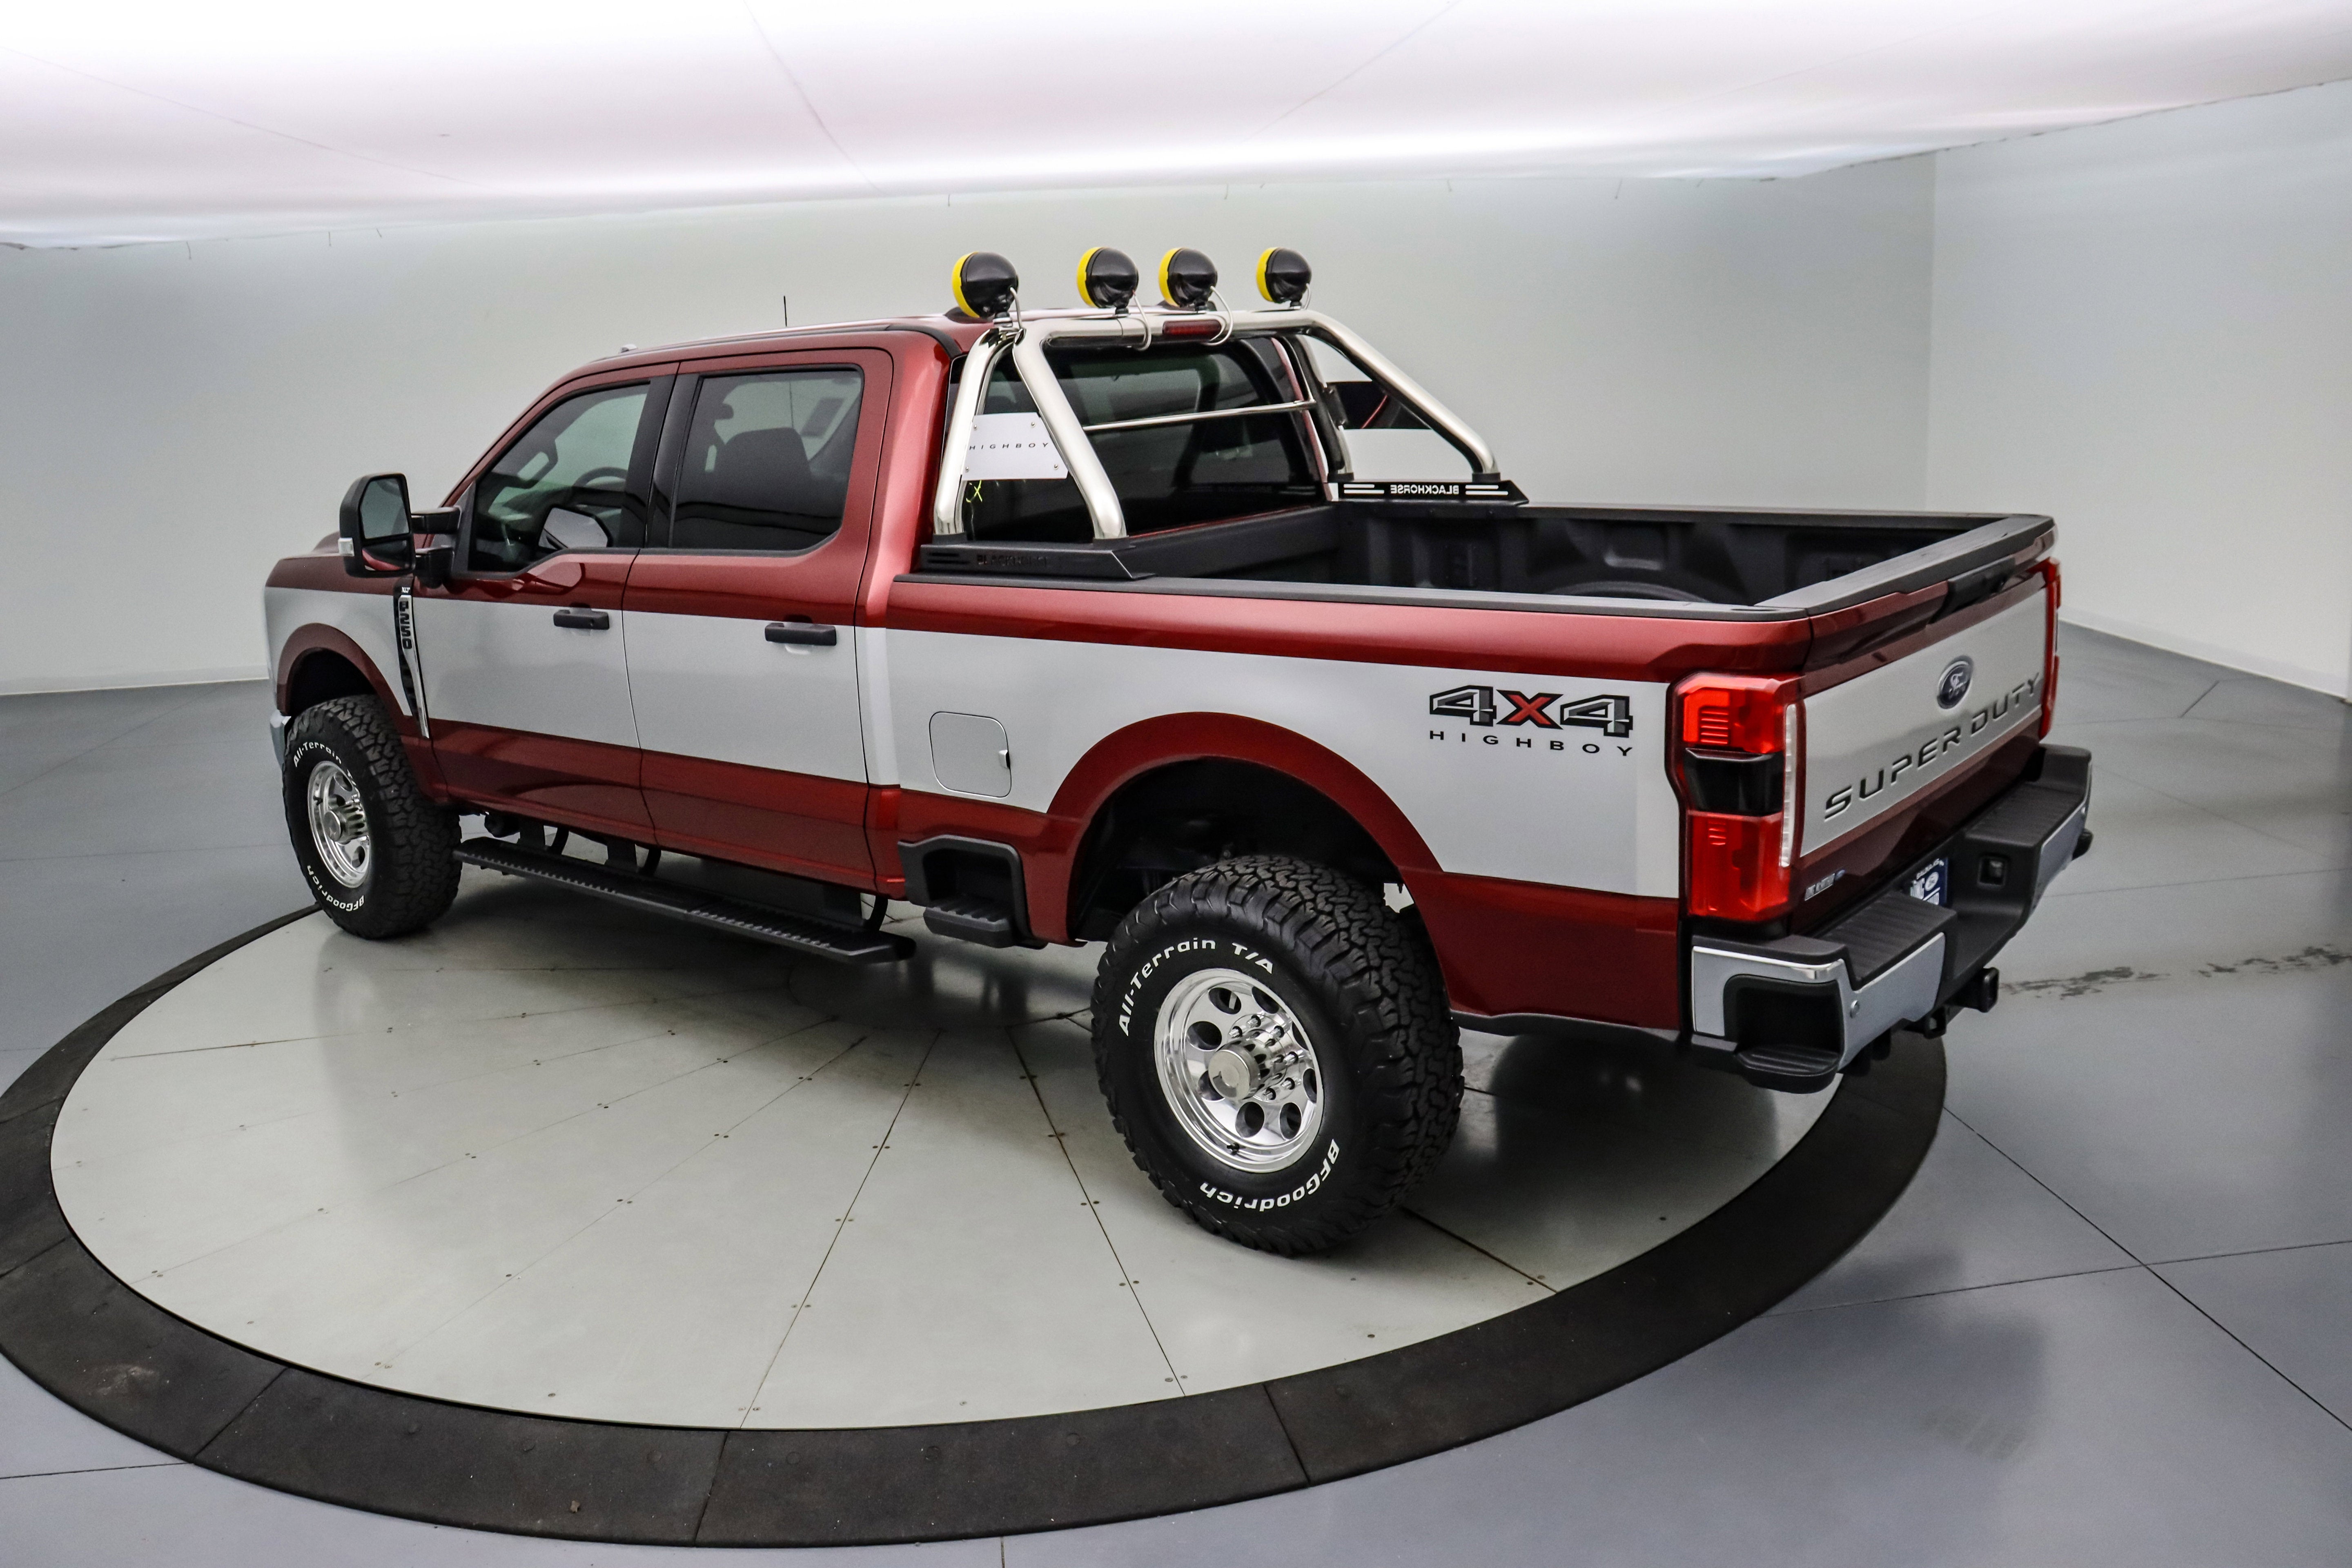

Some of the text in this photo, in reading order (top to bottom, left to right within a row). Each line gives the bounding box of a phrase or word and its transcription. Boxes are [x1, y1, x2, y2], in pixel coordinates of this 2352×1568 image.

[969, 442, 1049, 450] HIGHBOY
[1430, 730, 1633, 757] HIGHBOY
[1824, 672, 2040, 822] SUPER DUTY
[307, 865, 365, 911] BFGoodrich
[1119, 938, 1274, 1036] All-Terrain T/A
[1200, 1139, 1340, 1212] BFGoodrich
